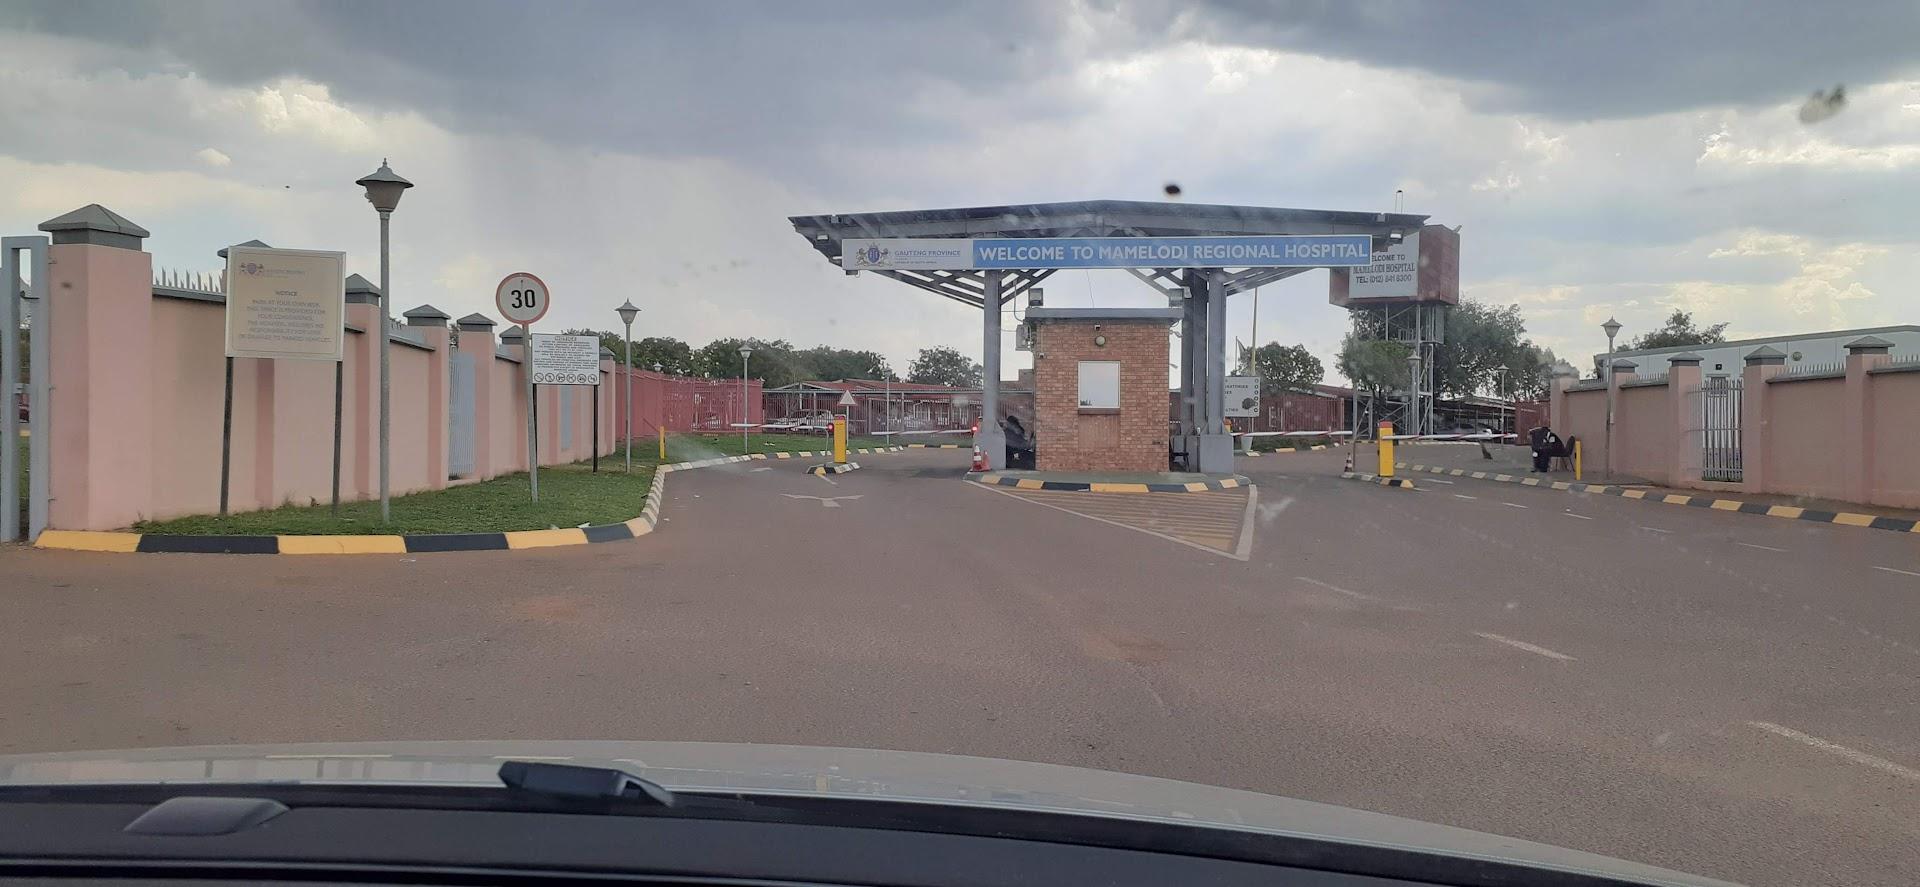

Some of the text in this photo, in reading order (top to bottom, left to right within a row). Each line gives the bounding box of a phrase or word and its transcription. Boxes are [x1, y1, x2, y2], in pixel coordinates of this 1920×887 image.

[979, 243, 1369, 261] WELCOME TO MAMELODI REGIONAL HOSPITAL
[1371, 254, 1396, 262] ELCOME
[1386, 262, 1416, 273] HOSPITAL
[511, 289, 536, 309] 30
